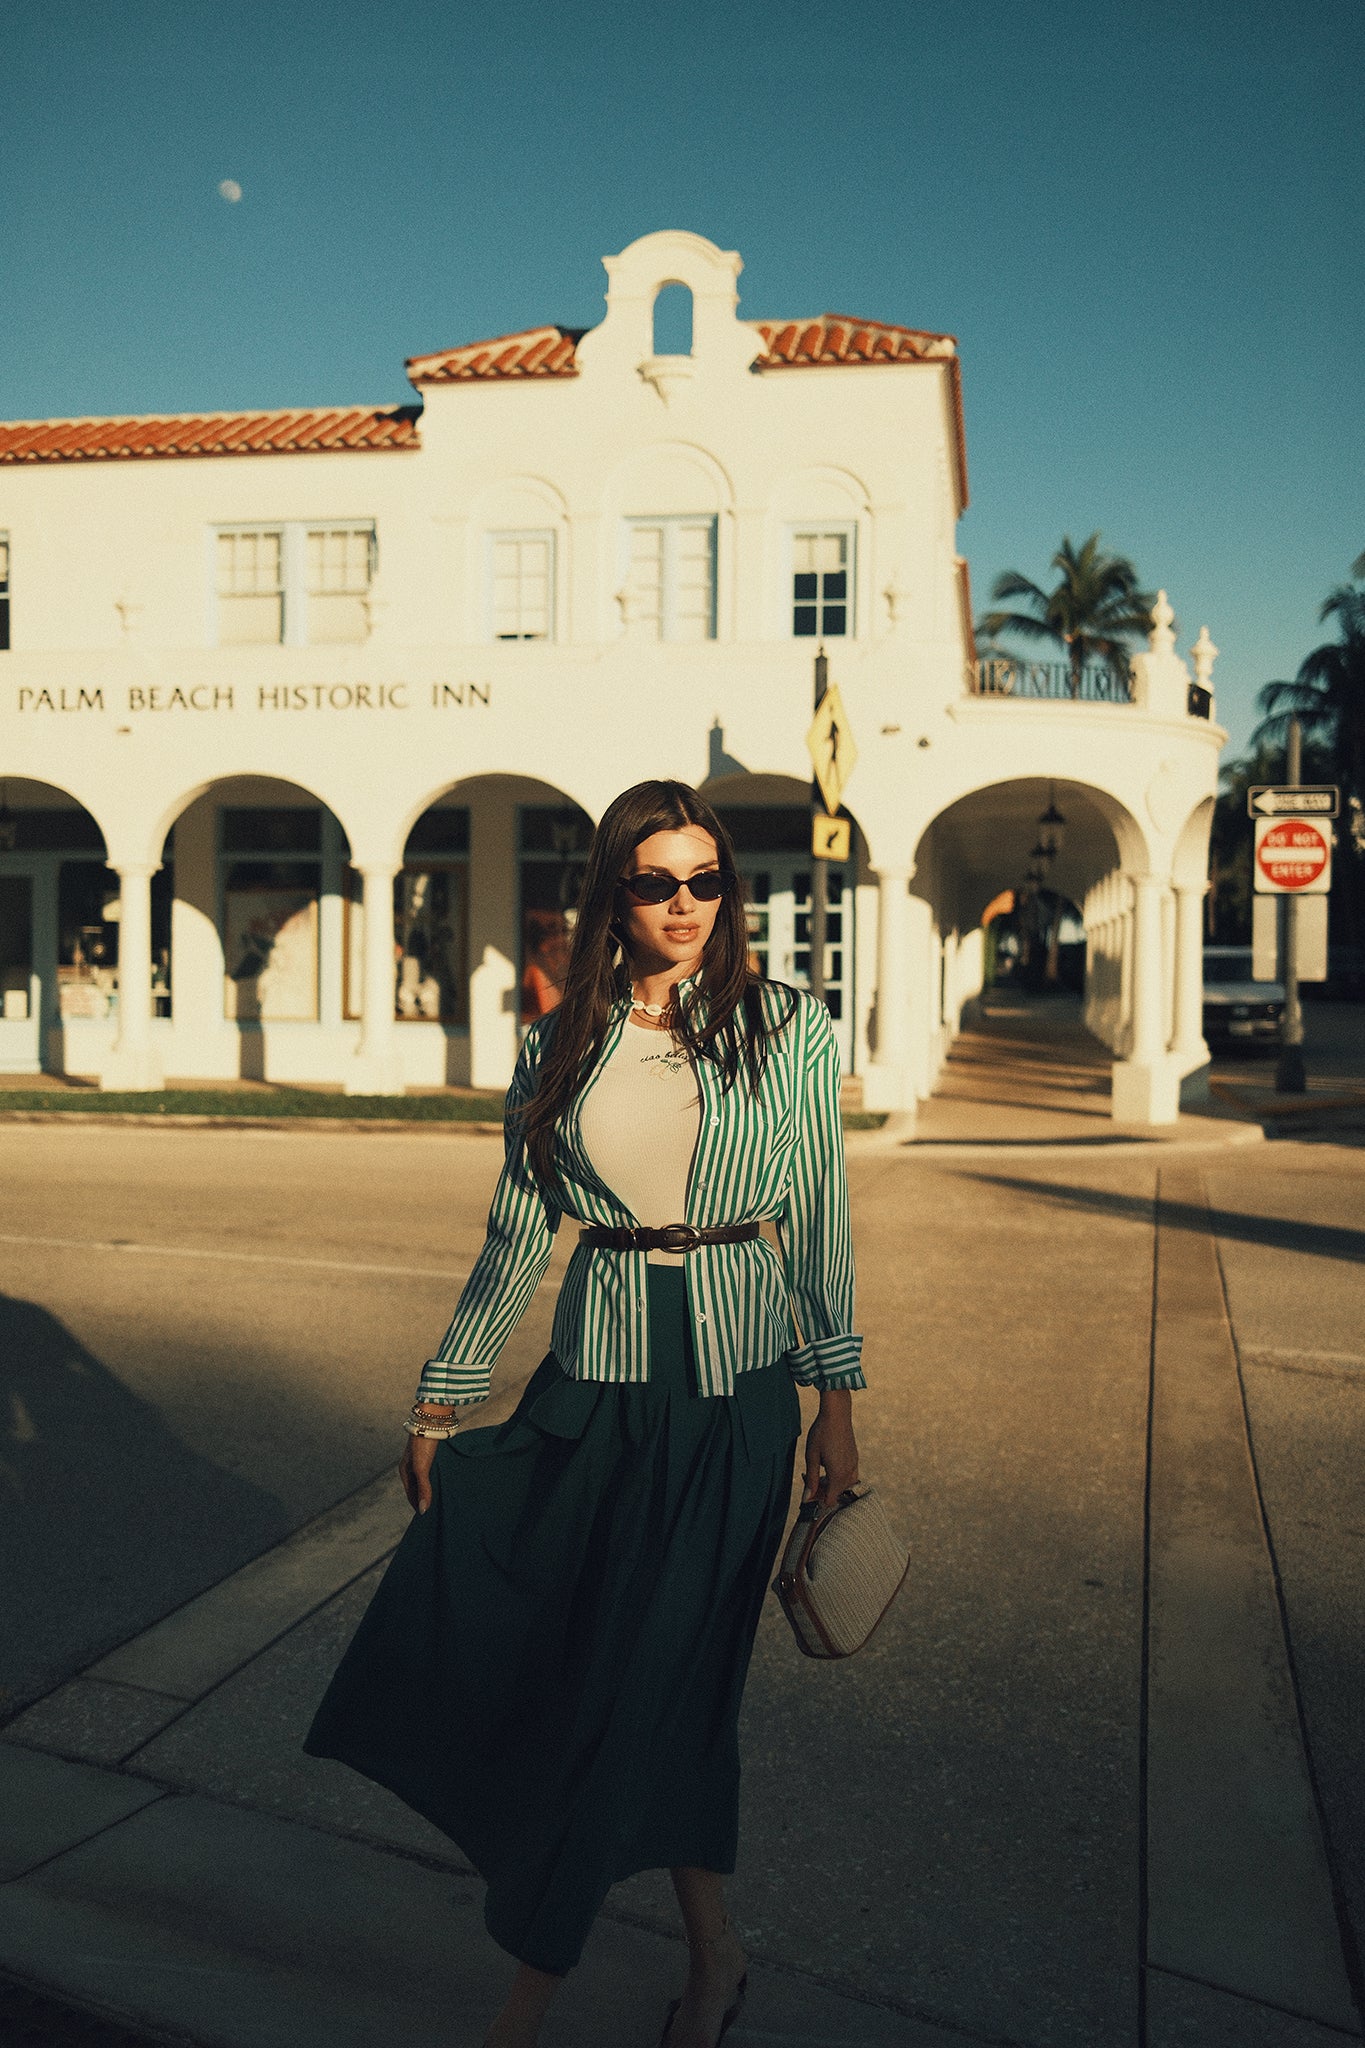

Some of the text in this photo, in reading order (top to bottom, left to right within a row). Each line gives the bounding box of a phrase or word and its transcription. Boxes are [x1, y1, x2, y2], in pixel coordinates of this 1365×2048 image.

[18, 683, 492, 712] PALM BEACH HISTORIC INN
[1267, 832, 1318, 847] DO NOT
[1271, 864, 1313, 878] ENTER
